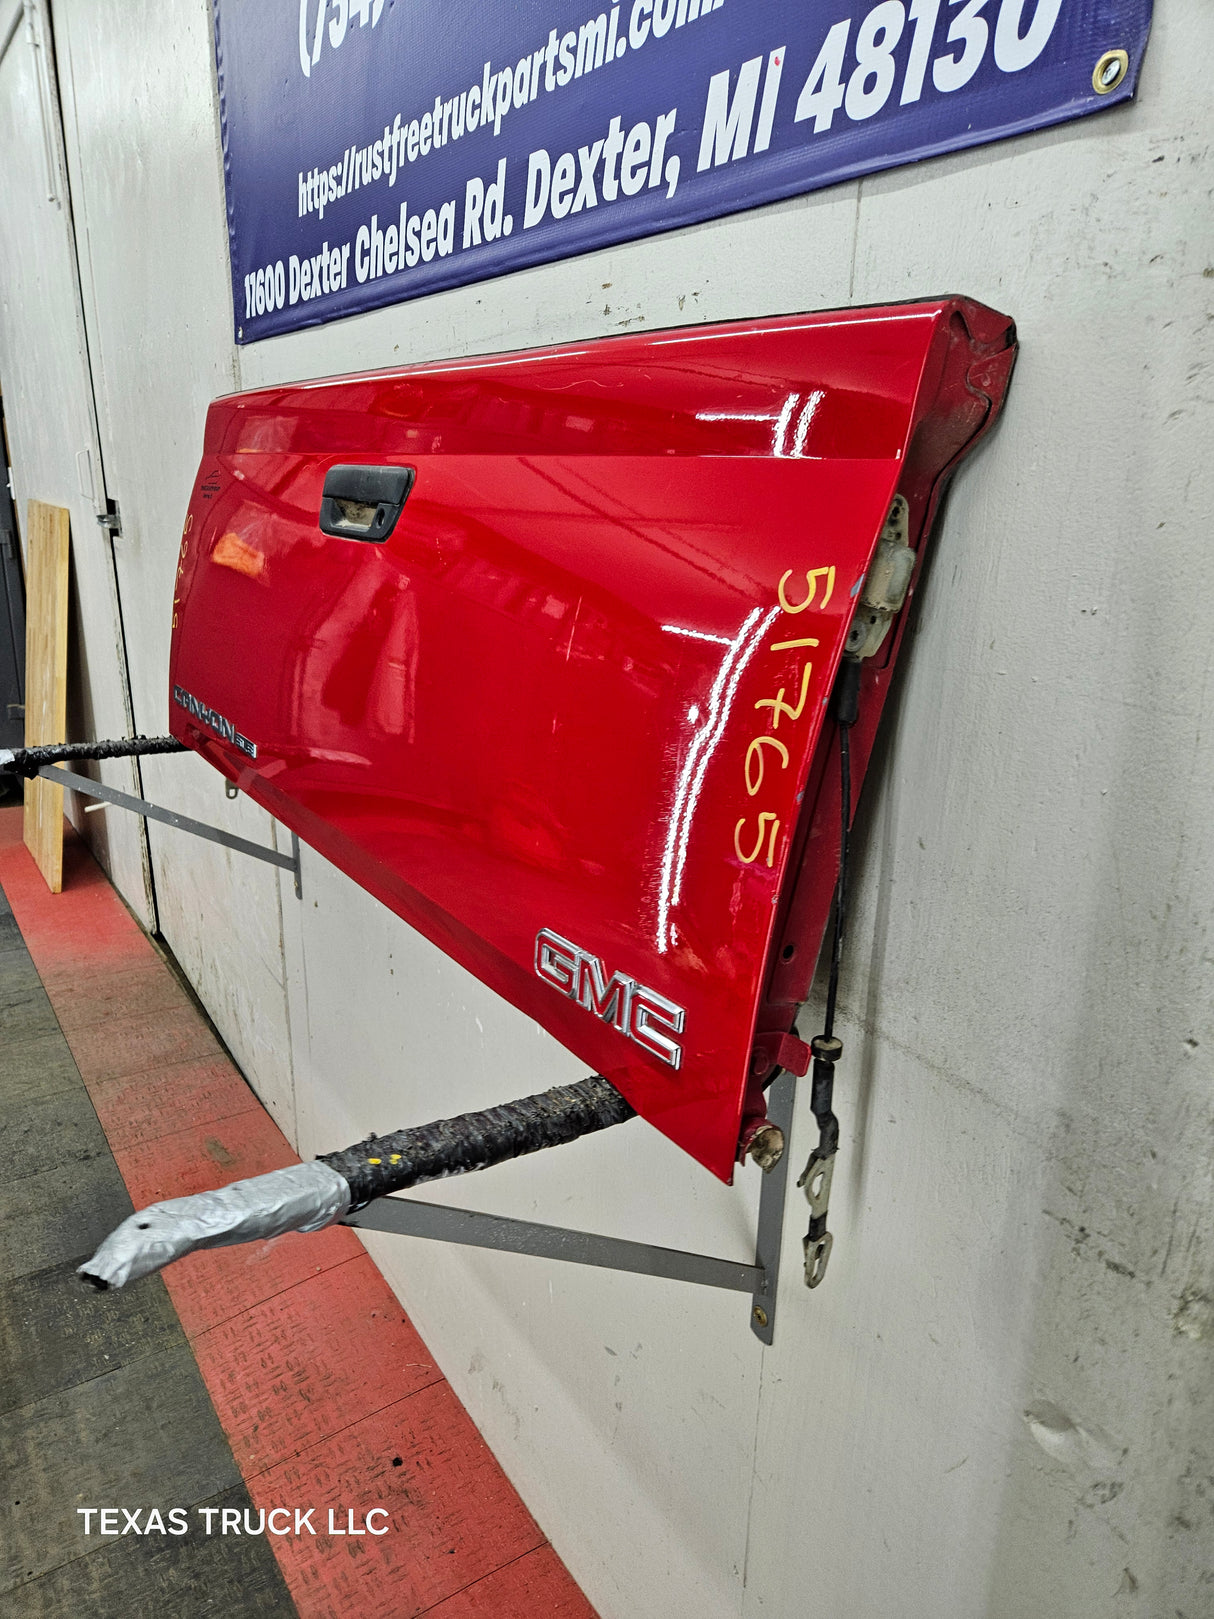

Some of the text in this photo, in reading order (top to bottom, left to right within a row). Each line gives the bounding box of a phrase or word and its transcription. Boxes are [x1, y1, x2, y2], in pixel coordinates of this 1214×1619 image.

[244, 0, 1063, 319] 11600 Dexter Chelsea Rd. Dexter, MI 48130
[298, 0, 725, 218] https://rustfreetruckpartsmi.co
[173, 684, 236, 744] CANYON
[734, 566, 835, 868] 51765
[534, 927, 687, 1071] GMC
